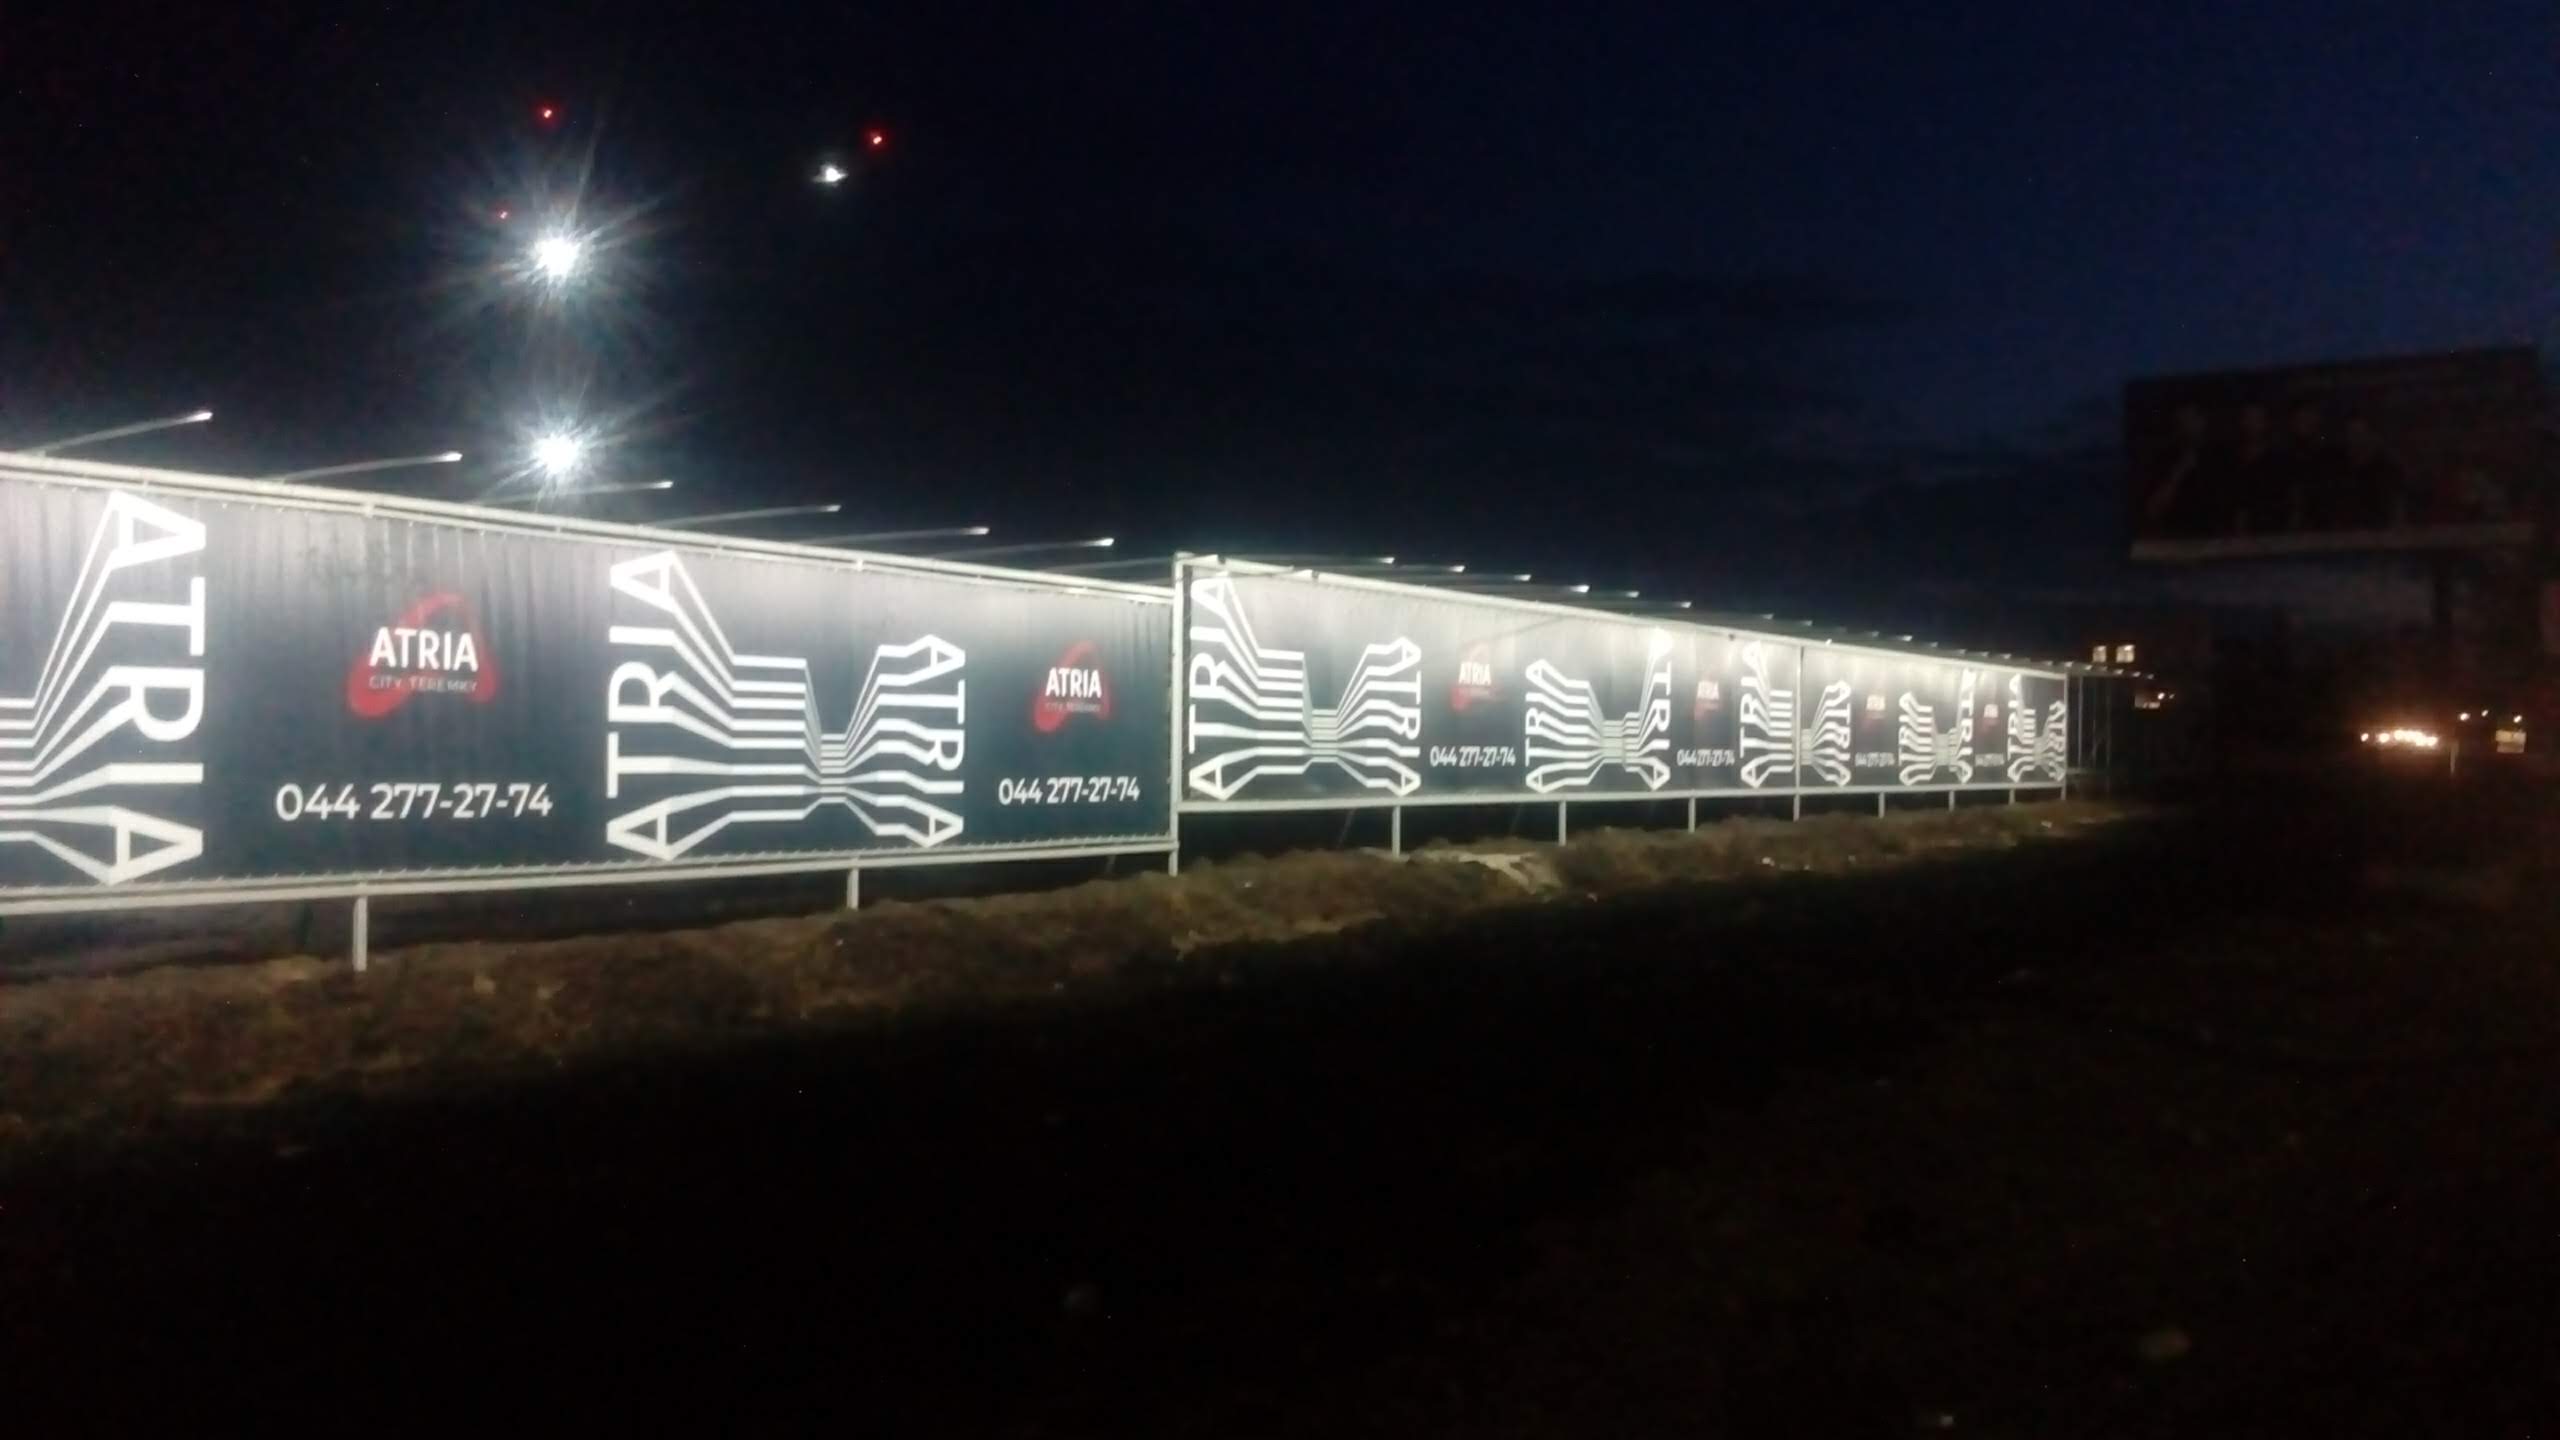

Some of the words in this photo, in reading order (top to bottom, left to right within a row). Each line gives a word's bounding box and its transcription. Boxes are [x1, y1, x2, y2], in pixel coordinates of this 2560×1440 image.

[108, 489, 207, 885] ATRIA
[368, 627, 479, 672] ATRIA
[368, 675, 402, 690] CITY
[1045, 666, 1102, 698] ATRIA
[1188, 571, 1230, 800] ATRIA
[607, 550, 681, 861] ATRIA
[922, 634, 966, 847] ATRIA
[1396, 636, 1422, 796] ATRIA
[1525, 658, 1547, 793] ATRIA
[998, 777, 1043, 805] 044
[1046, 776, 1140, 804] 277-27-74
[1429, 745, 1457, 767] 044
[1458, 745, 1516, 767] 277-27-74
[276, 783, 360, 821] 044
[370, 783, 553, 819] 277-27-74
